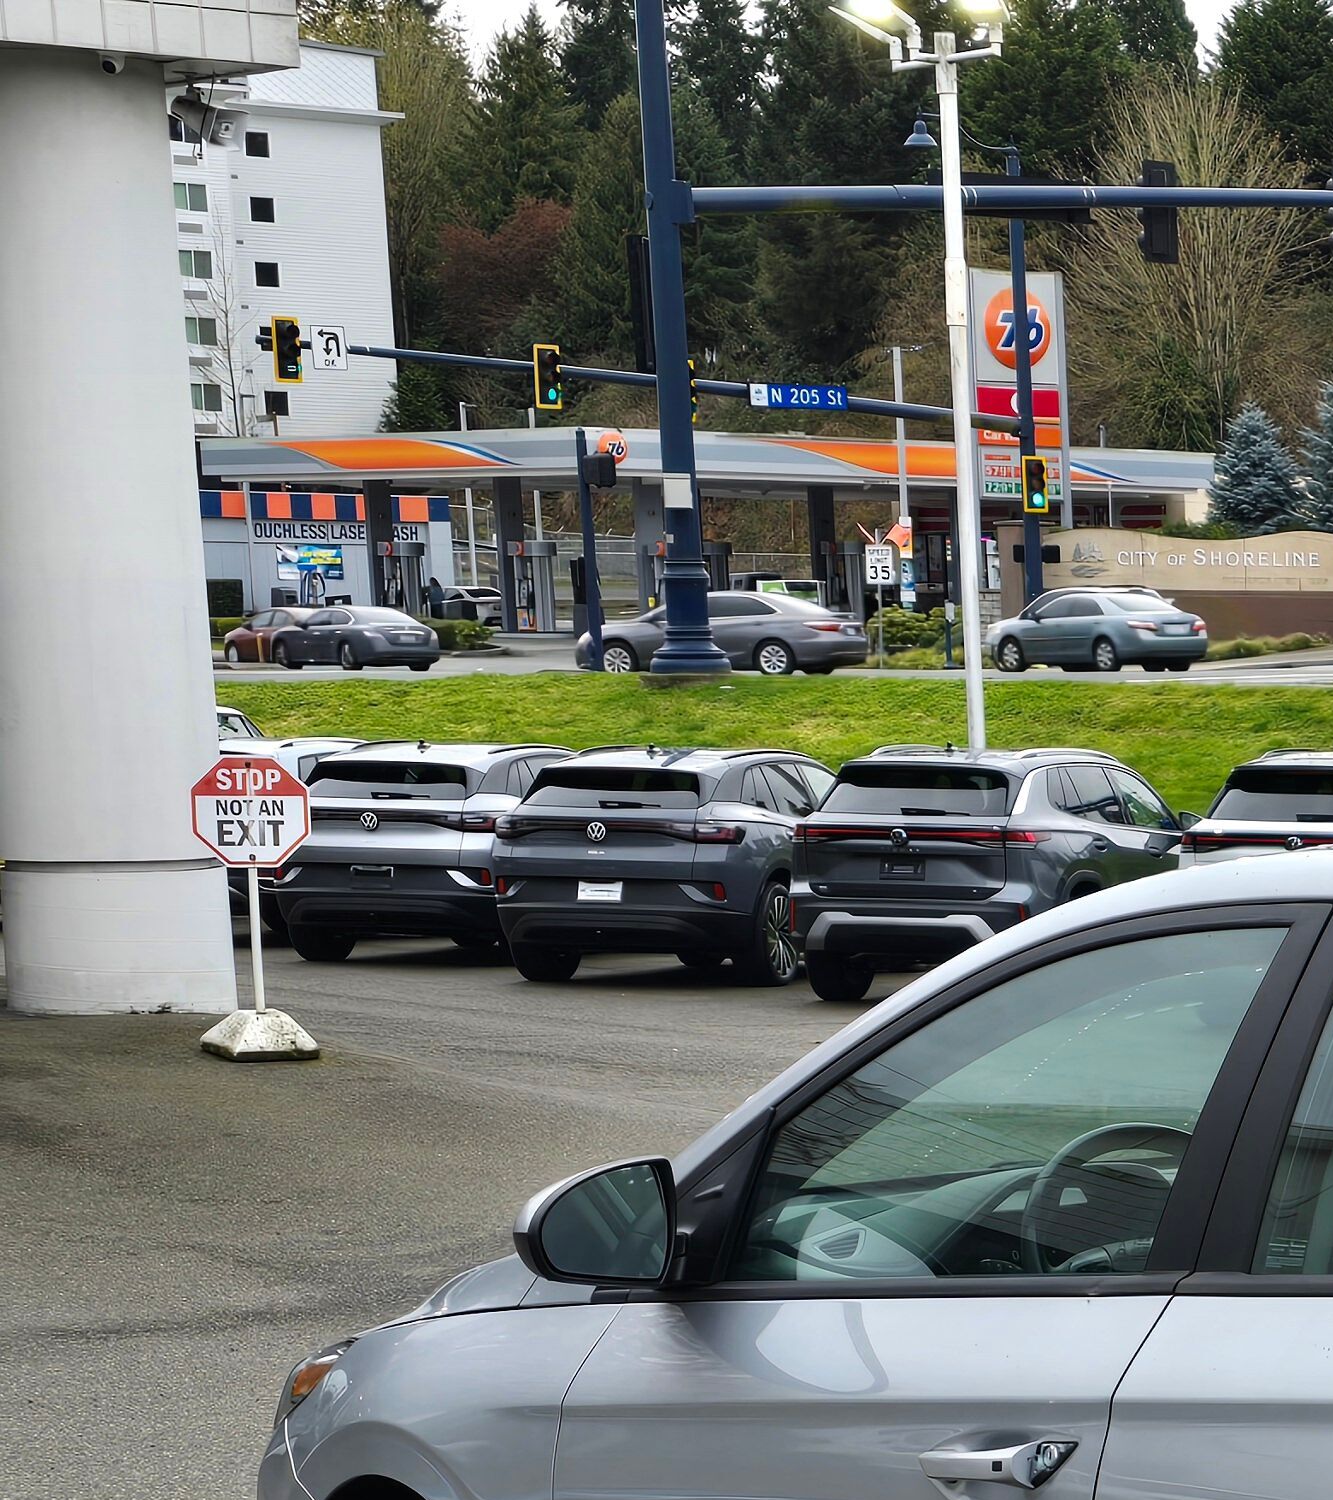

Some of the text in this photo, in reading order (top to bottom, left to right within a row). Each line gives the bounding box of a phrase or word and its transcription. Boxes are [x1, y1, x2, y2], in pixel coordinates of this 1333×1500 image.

[997, 306, 1045, 350] 76
[771, 387, 783, 403] N
[790, 388, 820, 404] 205
[827, 389, 842, 405] St
[608, 441, 625, 456] 76
[254, 523, 418, 541] OUCHLESS LASE ASH
[1117, 550, 1158, 566] CITY
[1192, 549, 1321, 568] SHORELINE
[869, 565, 890, 580] 35
[215, 768, 281, 791] STOP
[215, 799, 284, 817] NOT AN
[217, 819, 285, 847] EXIT
